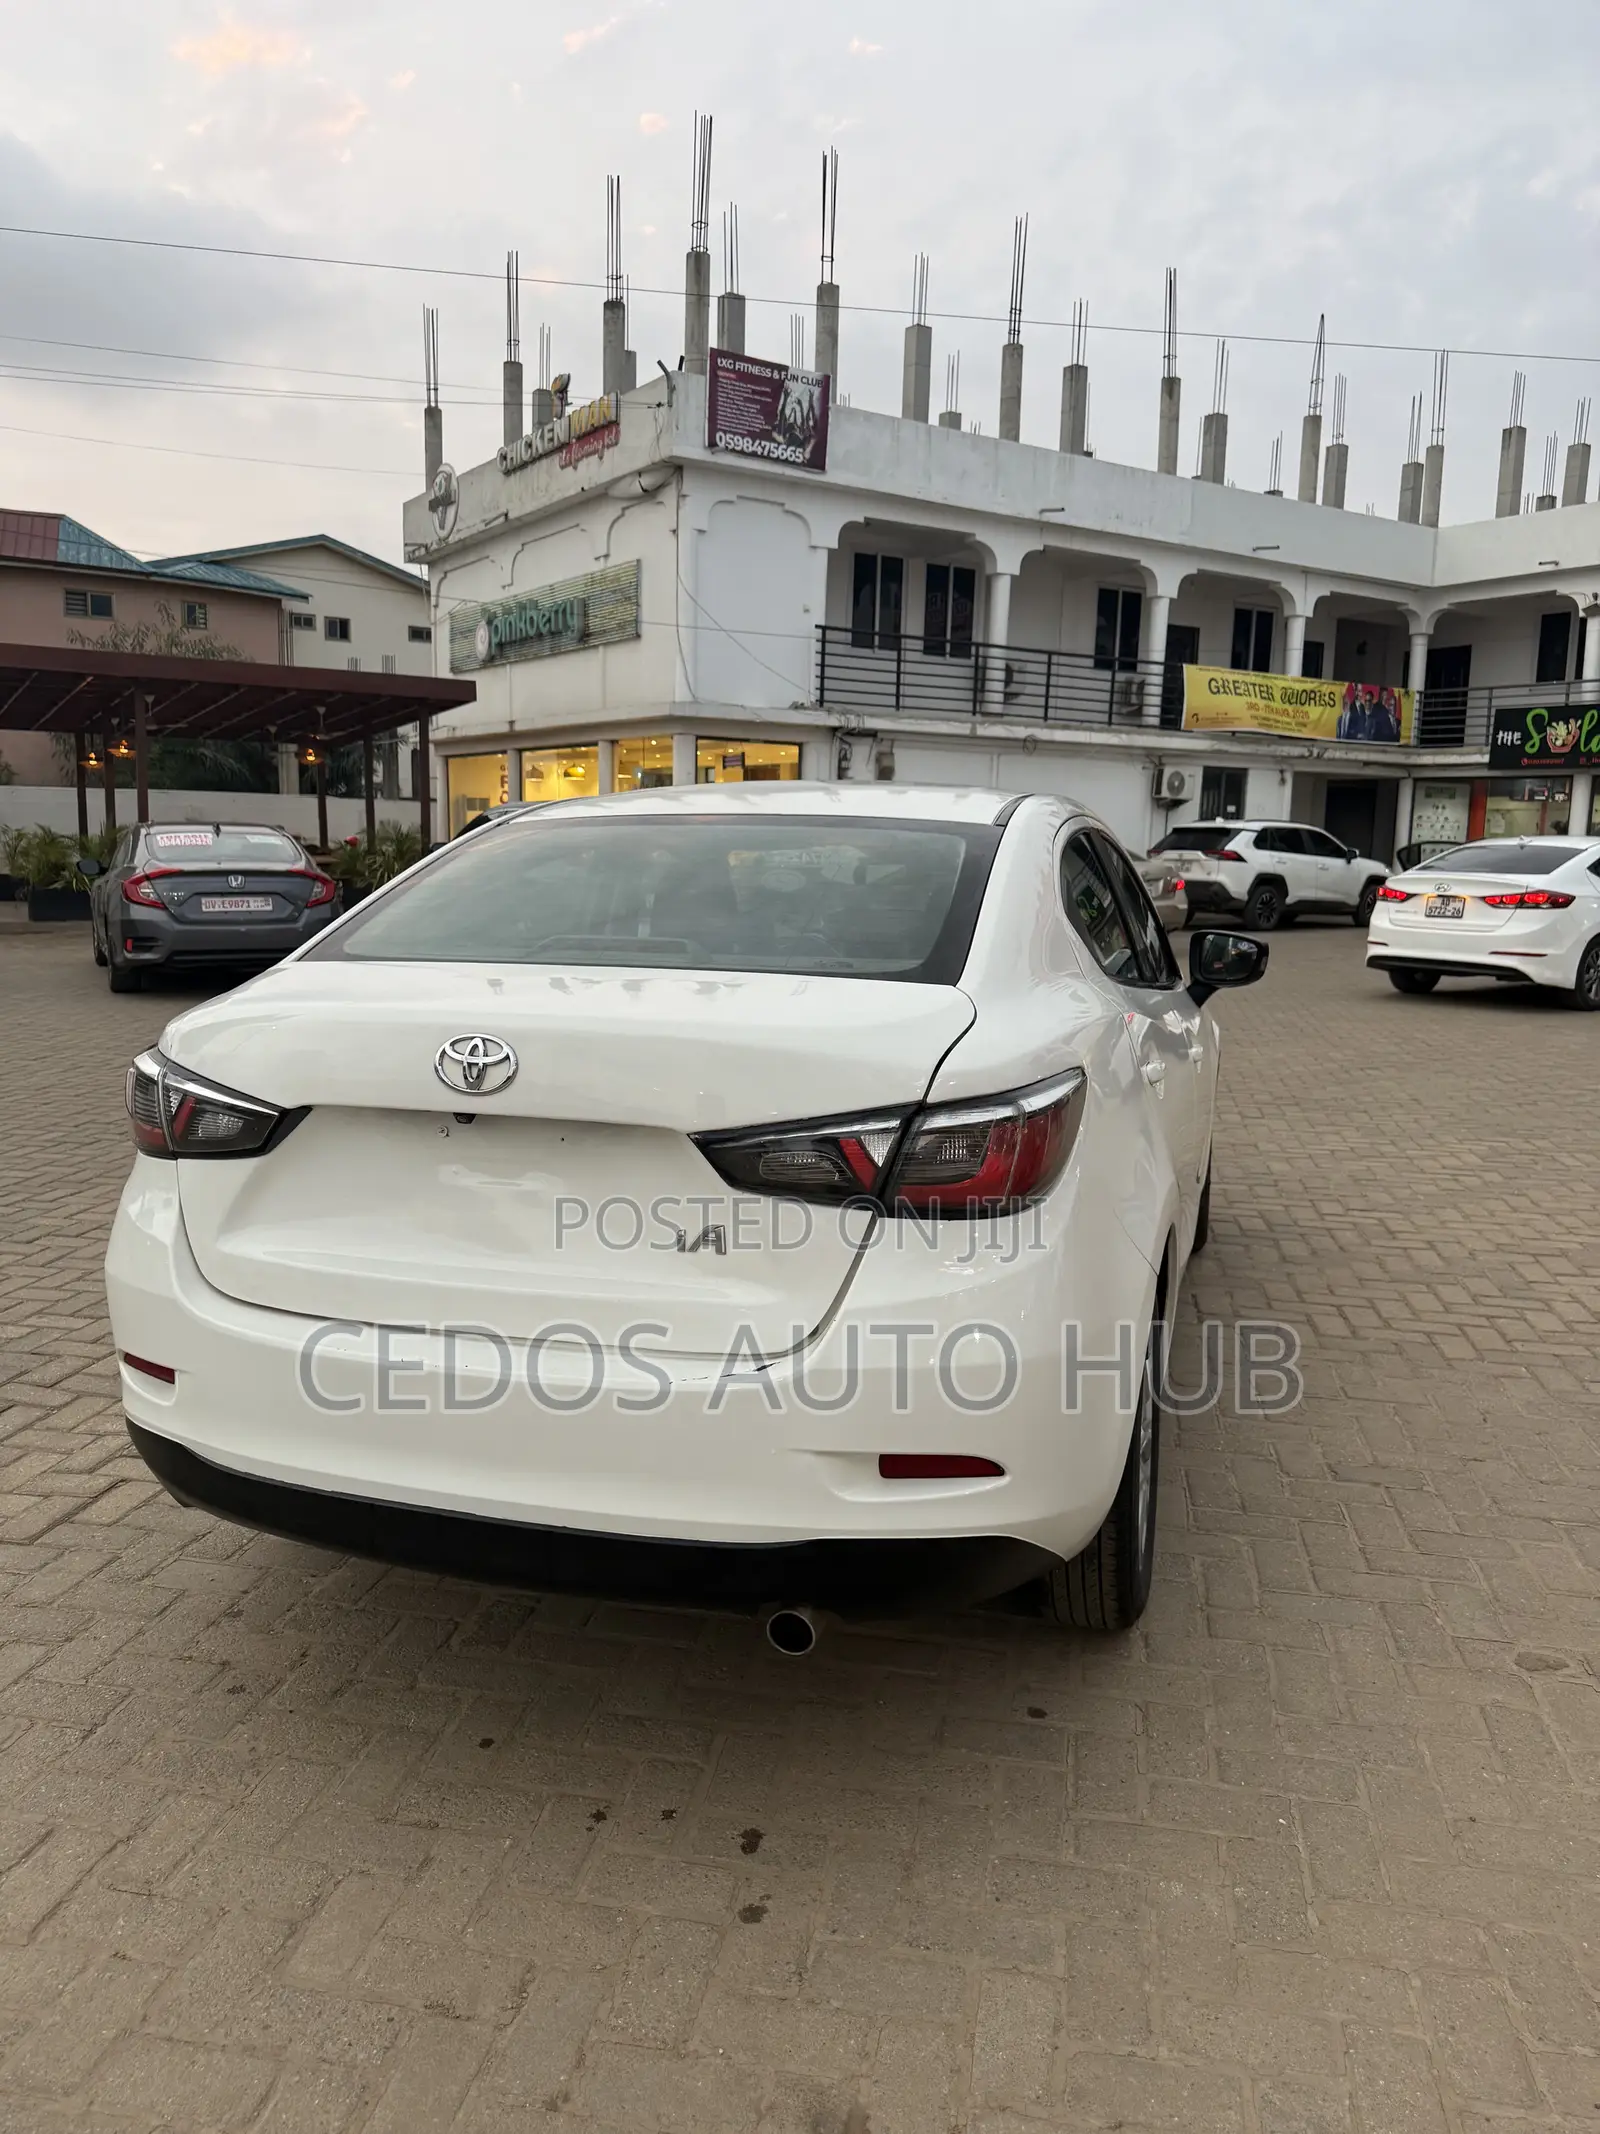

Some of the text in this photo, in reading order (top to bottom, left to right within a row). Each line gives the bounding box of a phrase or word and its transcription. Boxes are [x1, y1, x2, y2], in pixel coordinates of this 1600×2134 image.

[736, 361, 771, 378] FITNESS
[772, 369, 780, 379] &
[781, 371, 799, 384] FUN
[800, 375, 824, 388] CLUB
[497, 394, 614, 473] CHICKEN MAN
[716, 431, 804, 463] 0598475665
[490, 599, 580, 650] pinkberry
[1208, 677, 1336, 708] GREATER WORKS
